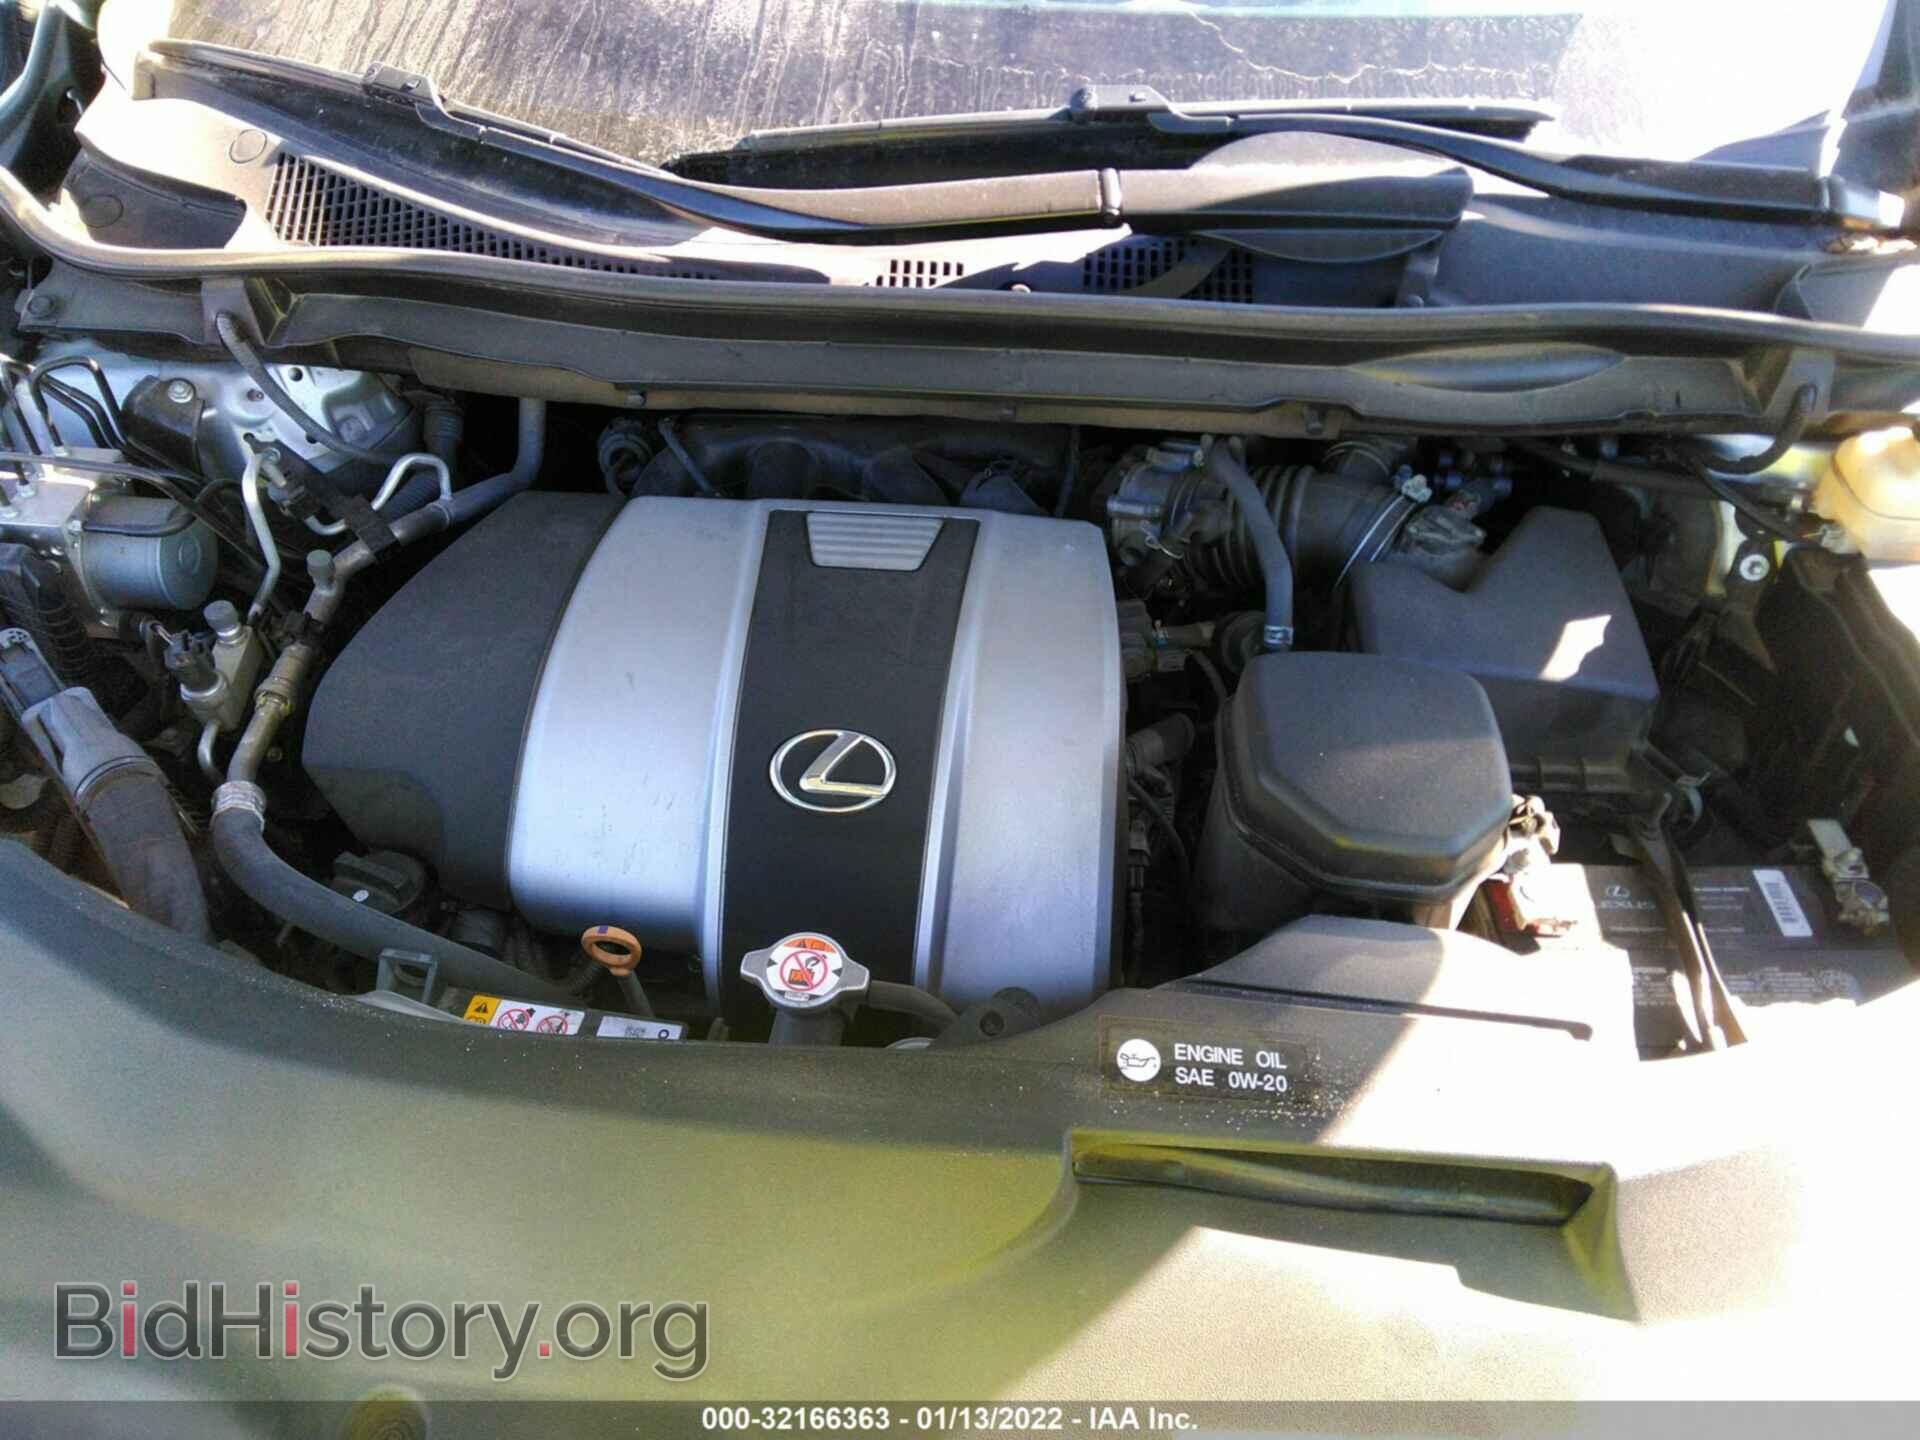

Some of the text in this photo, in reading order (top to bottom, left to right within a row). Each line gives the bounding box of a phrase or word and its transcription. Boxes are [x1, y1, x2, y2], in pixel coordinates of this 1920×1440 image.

[1174, 1043, 1289, 1070] ENGINE OIL
[1175, 1067, 1288, 1093] SAE 0W-20
